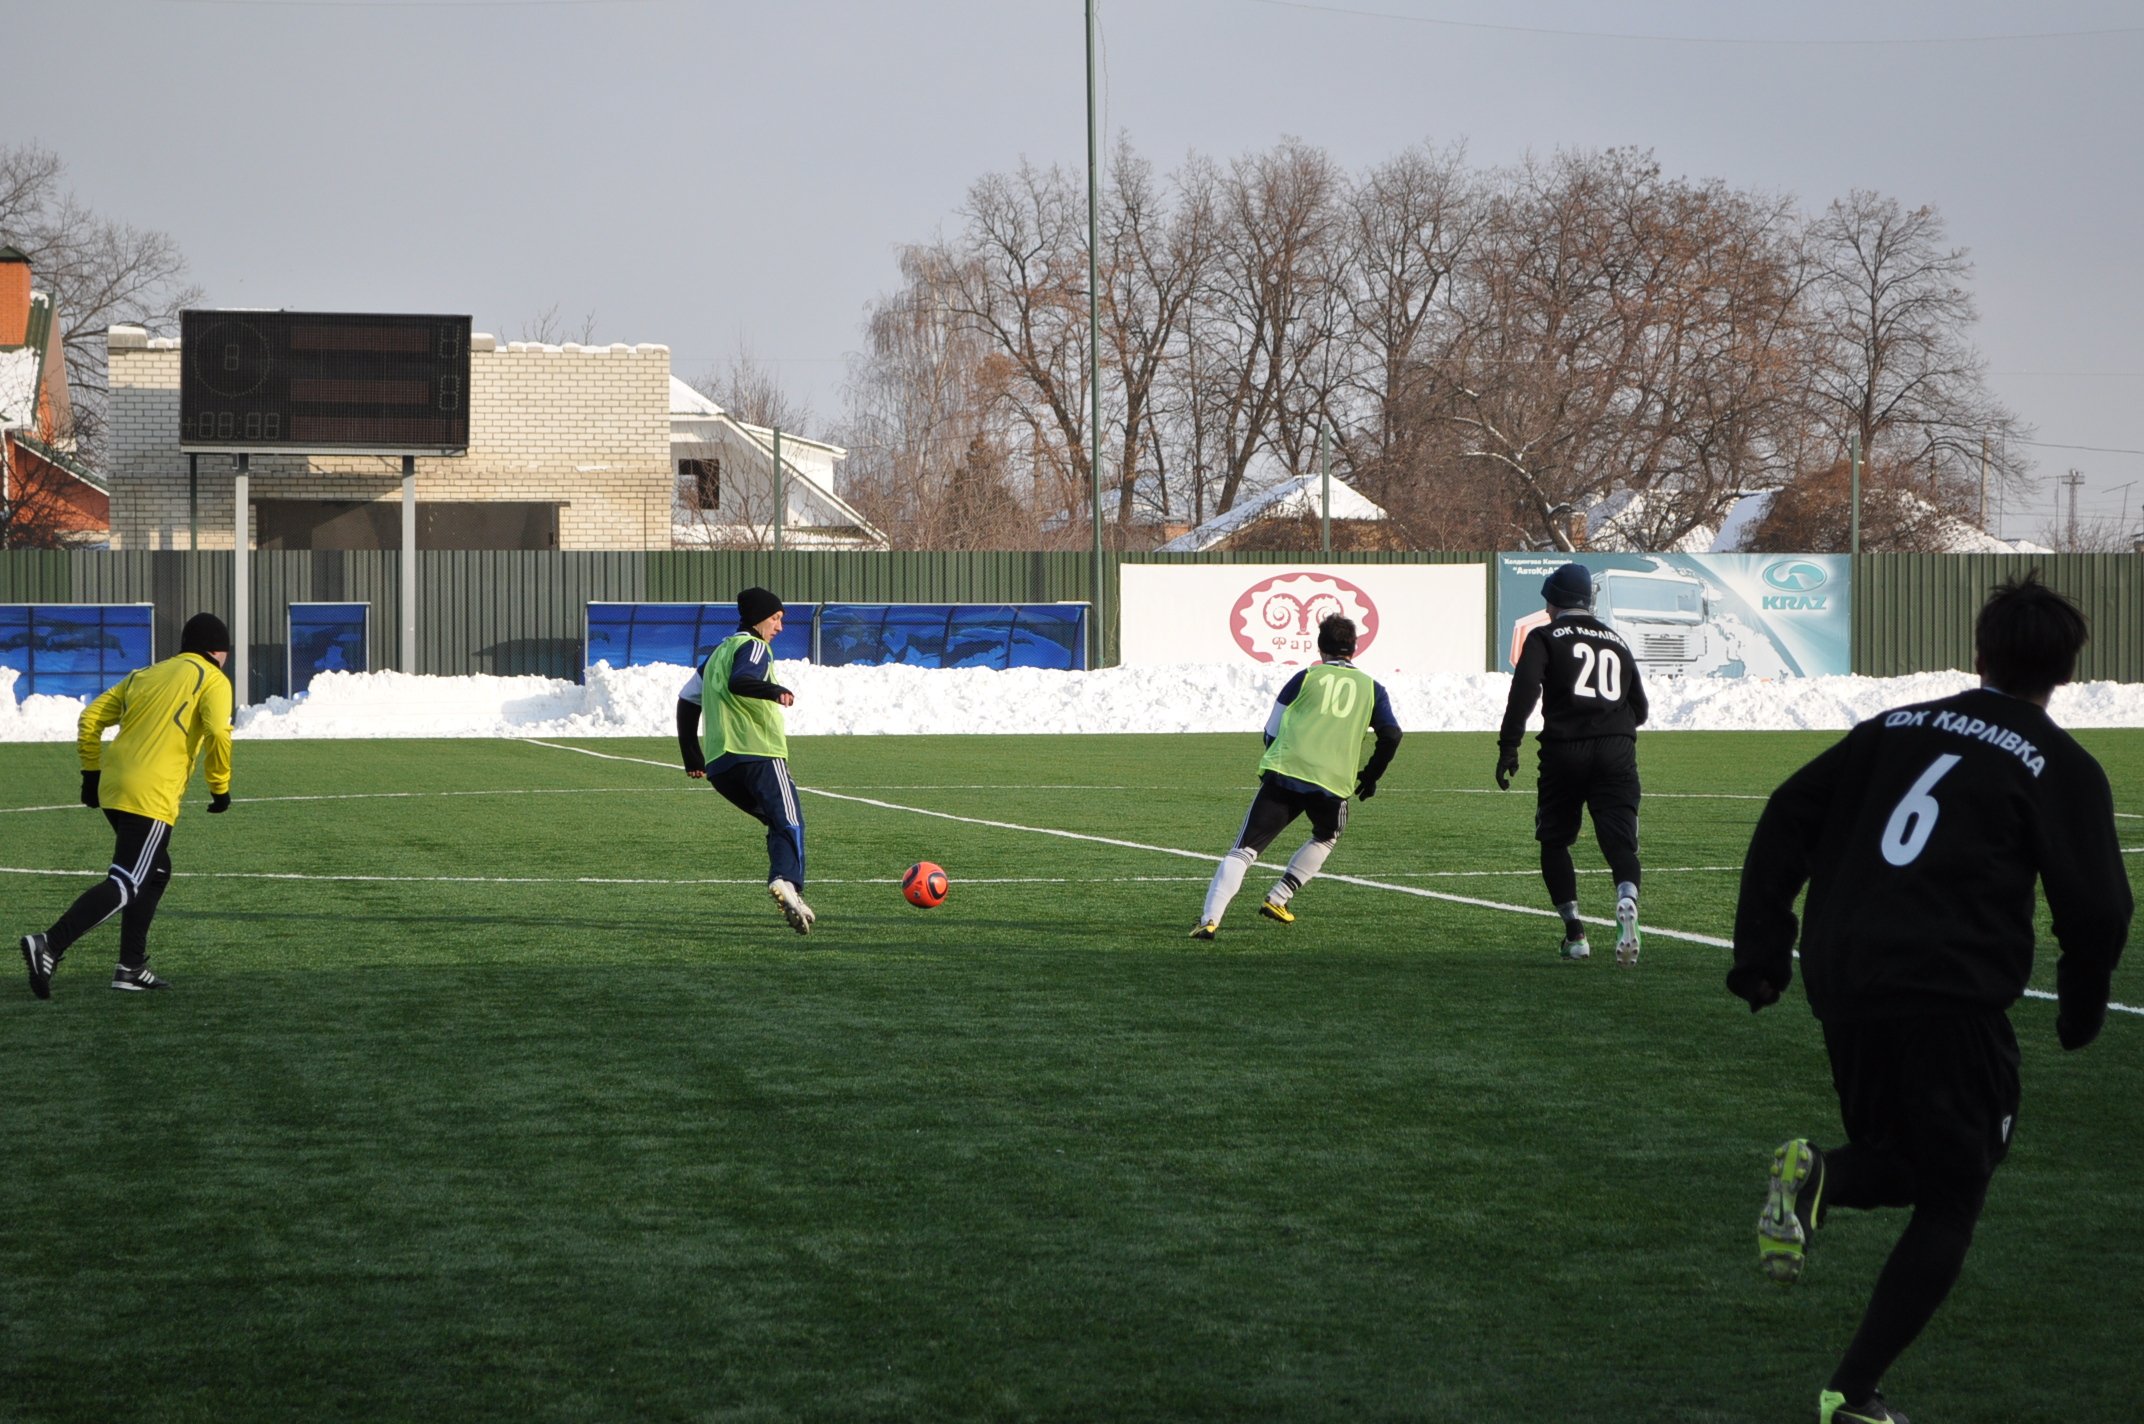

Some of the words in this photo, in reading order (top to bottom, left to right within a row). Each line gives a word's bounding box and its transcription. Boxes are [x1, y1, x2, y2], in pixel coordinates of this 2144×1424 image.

[1762, 595, 1826, 610] KRAZ
[1272, 636, 1319, 653] Фар
[1553, 626, 1574, 637] ФК
[1573, 642, 1622, 701] 20
[1319, 673, 1357, 718] 10
[1884, 710, 1931, 727] ФК
[1933, 709, 2046, 778] КАРЛІВКА
[1881, 753, 1963, 866] 6
